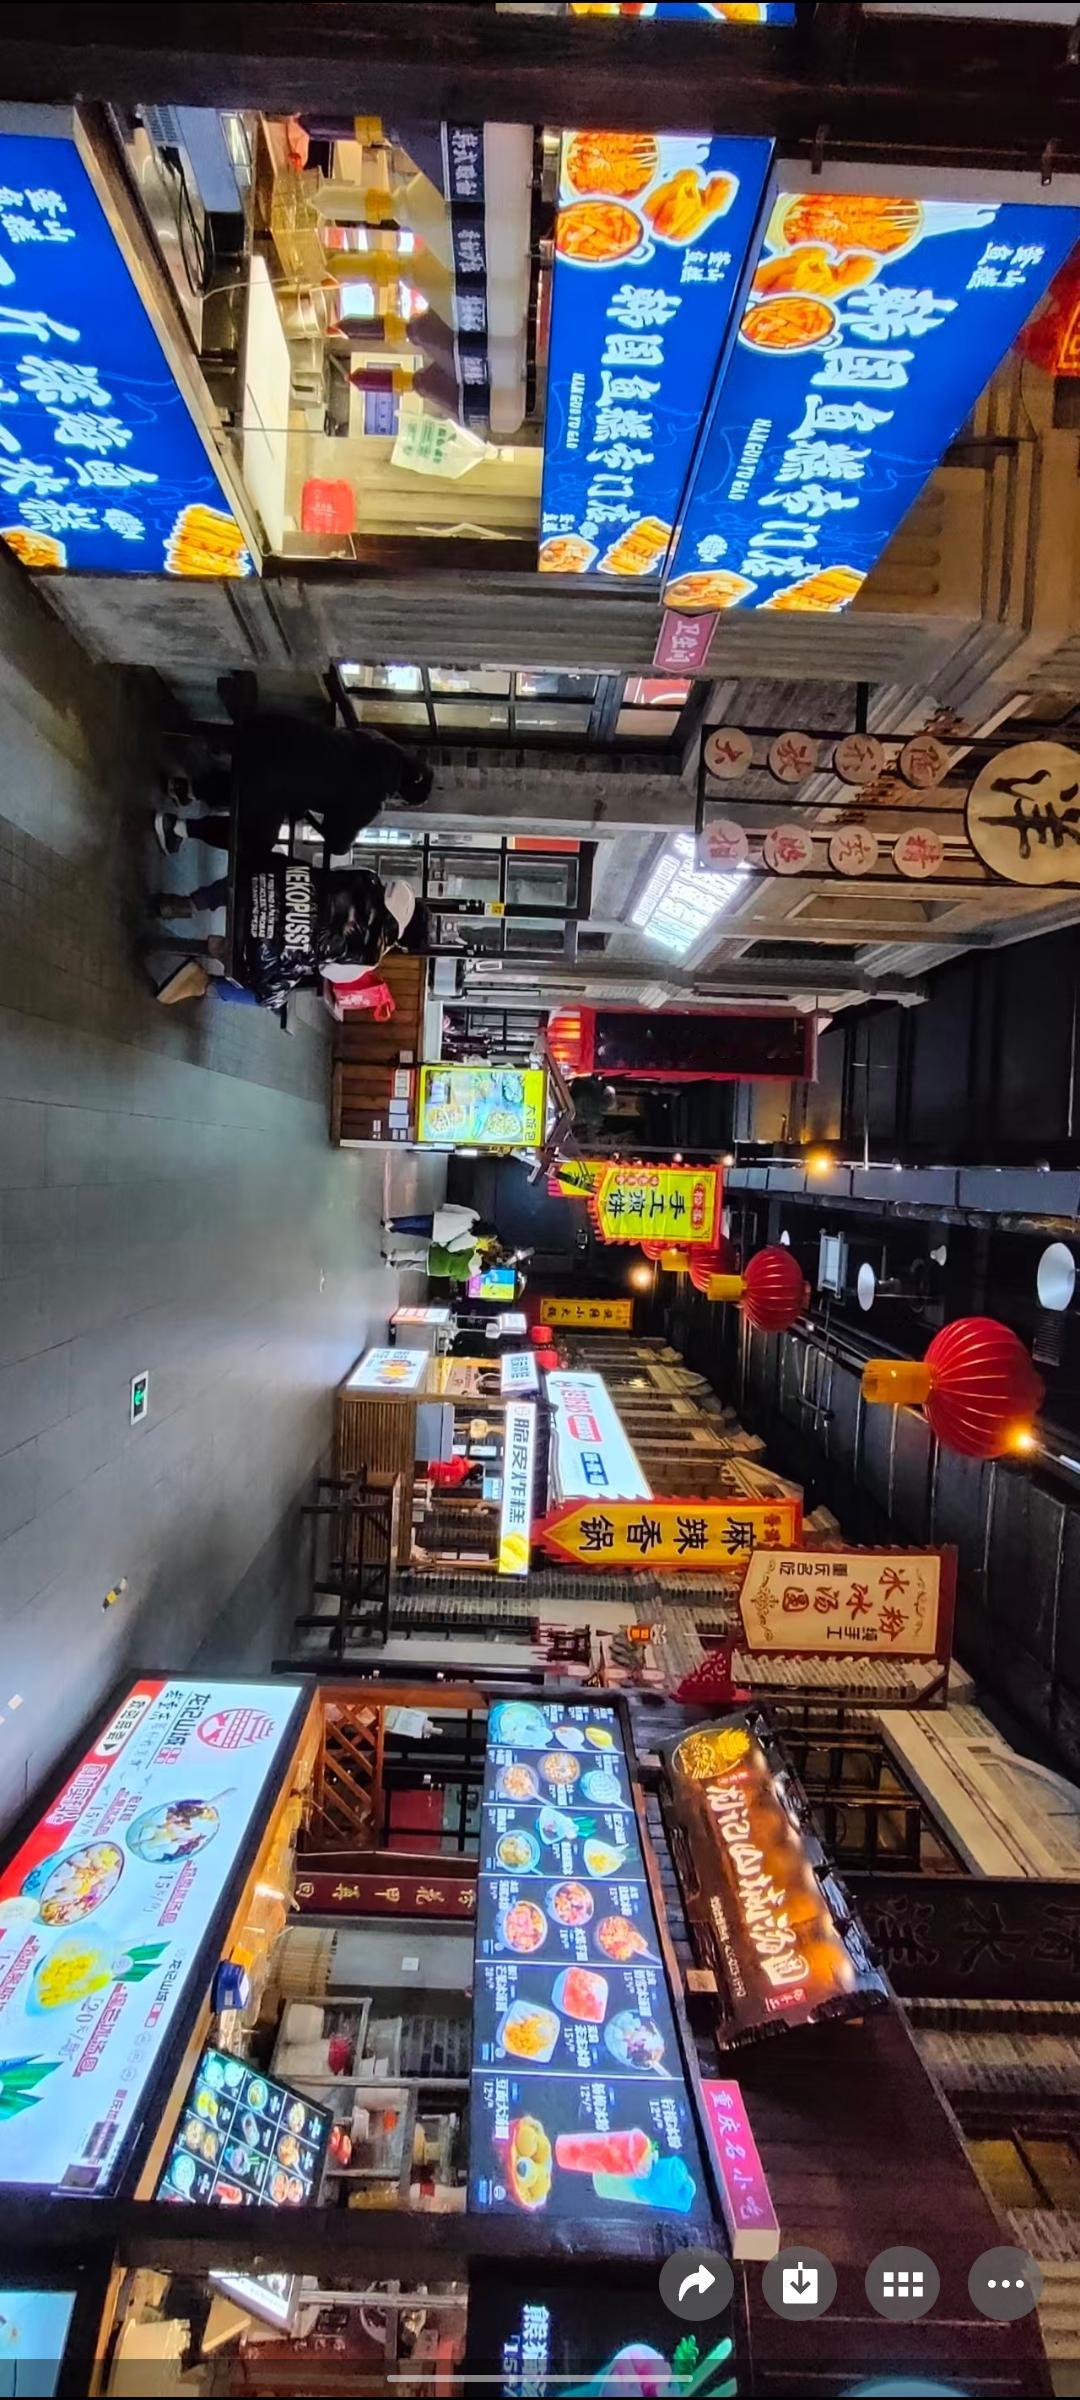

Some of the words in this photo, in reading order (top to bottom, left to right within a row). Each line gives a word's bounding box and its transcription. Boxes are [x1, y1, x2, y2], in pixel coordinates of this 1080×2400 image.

[29, 189, 75, 242] 釜山
[583, 284, 682, 524] 韩国鱼糕专门店
[739, 283, 959, 578] 韩国鱼糕专门店
[733, 465, 758, 481] YU
[736, 442, 766, 464] GUO
[727, 480, 755, 502] GAO
[665, 621, 703, 665] 卫生间
[978, 770, 1080, 860] 洋
[606, 1189, 686, 1220] 手工煎饼
[508, 1417, 530, 1526] 脆皮炸糕
[577, 1516, 756, 1555] 麻辣香锅
[778, 1562, 848, 1576] 重庆名吃
[709, 2090, 764, 2220] 重庆名小吃
